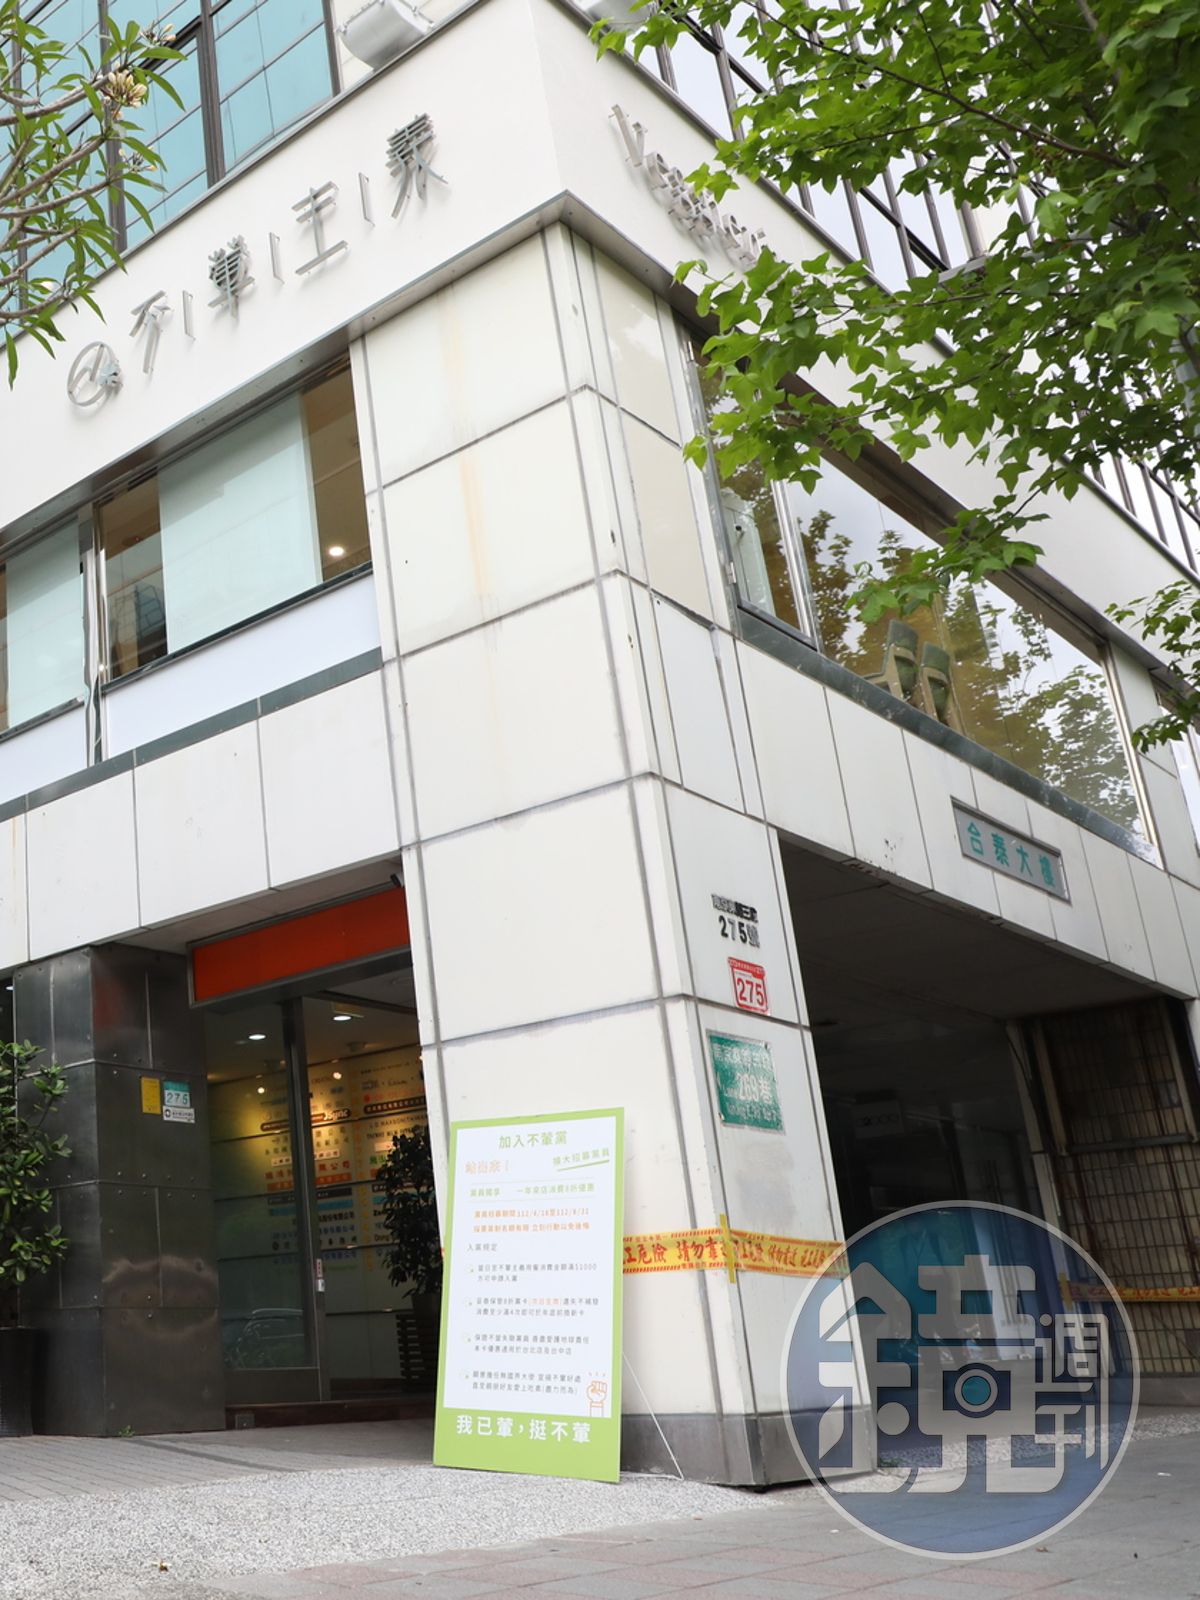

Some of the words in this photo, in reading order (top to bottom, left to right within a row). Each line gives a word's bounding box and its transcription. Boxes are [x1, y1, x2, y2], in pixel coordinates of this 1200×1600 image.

[737, 978, 764, 1006] 275
[166, 1092, 188, 1105] 275
[623, 1245, 668, 1265] 工危險
